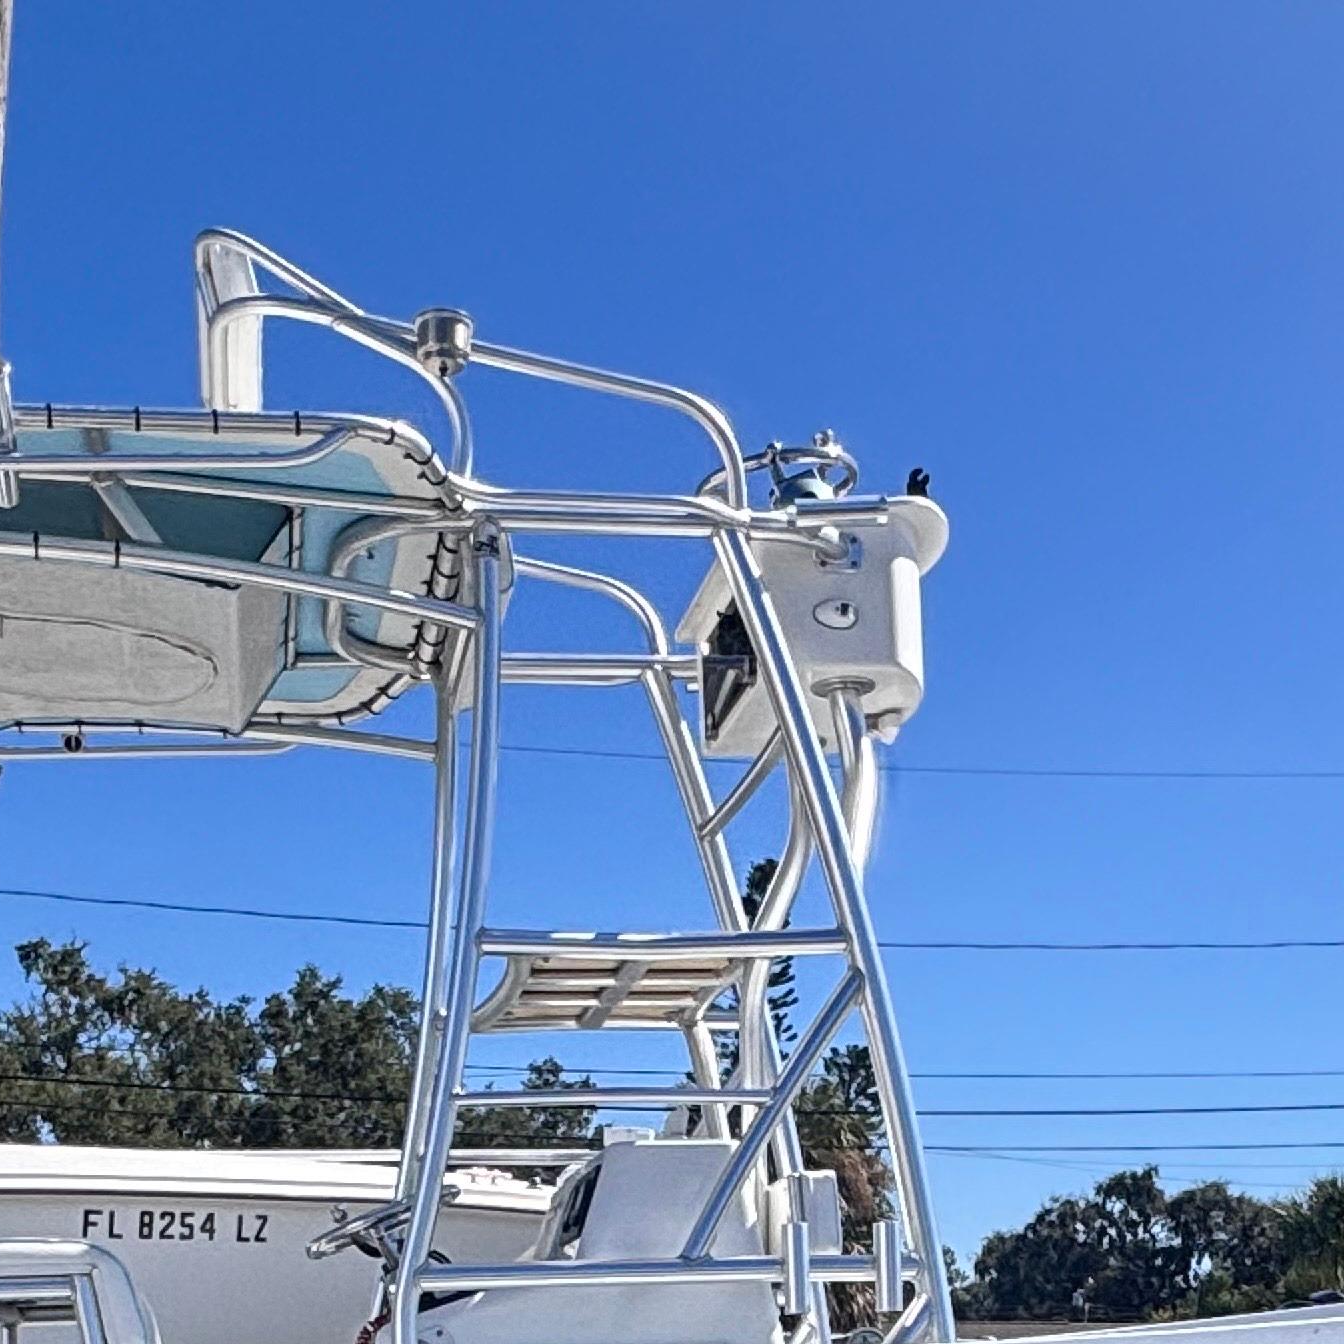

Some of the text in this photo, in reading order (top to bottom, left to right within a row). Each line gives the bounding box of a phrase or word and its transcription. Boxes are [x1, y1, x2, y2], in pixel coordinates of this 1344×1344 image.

[82, 1209, 269, 1243] FL 8254 LZ
